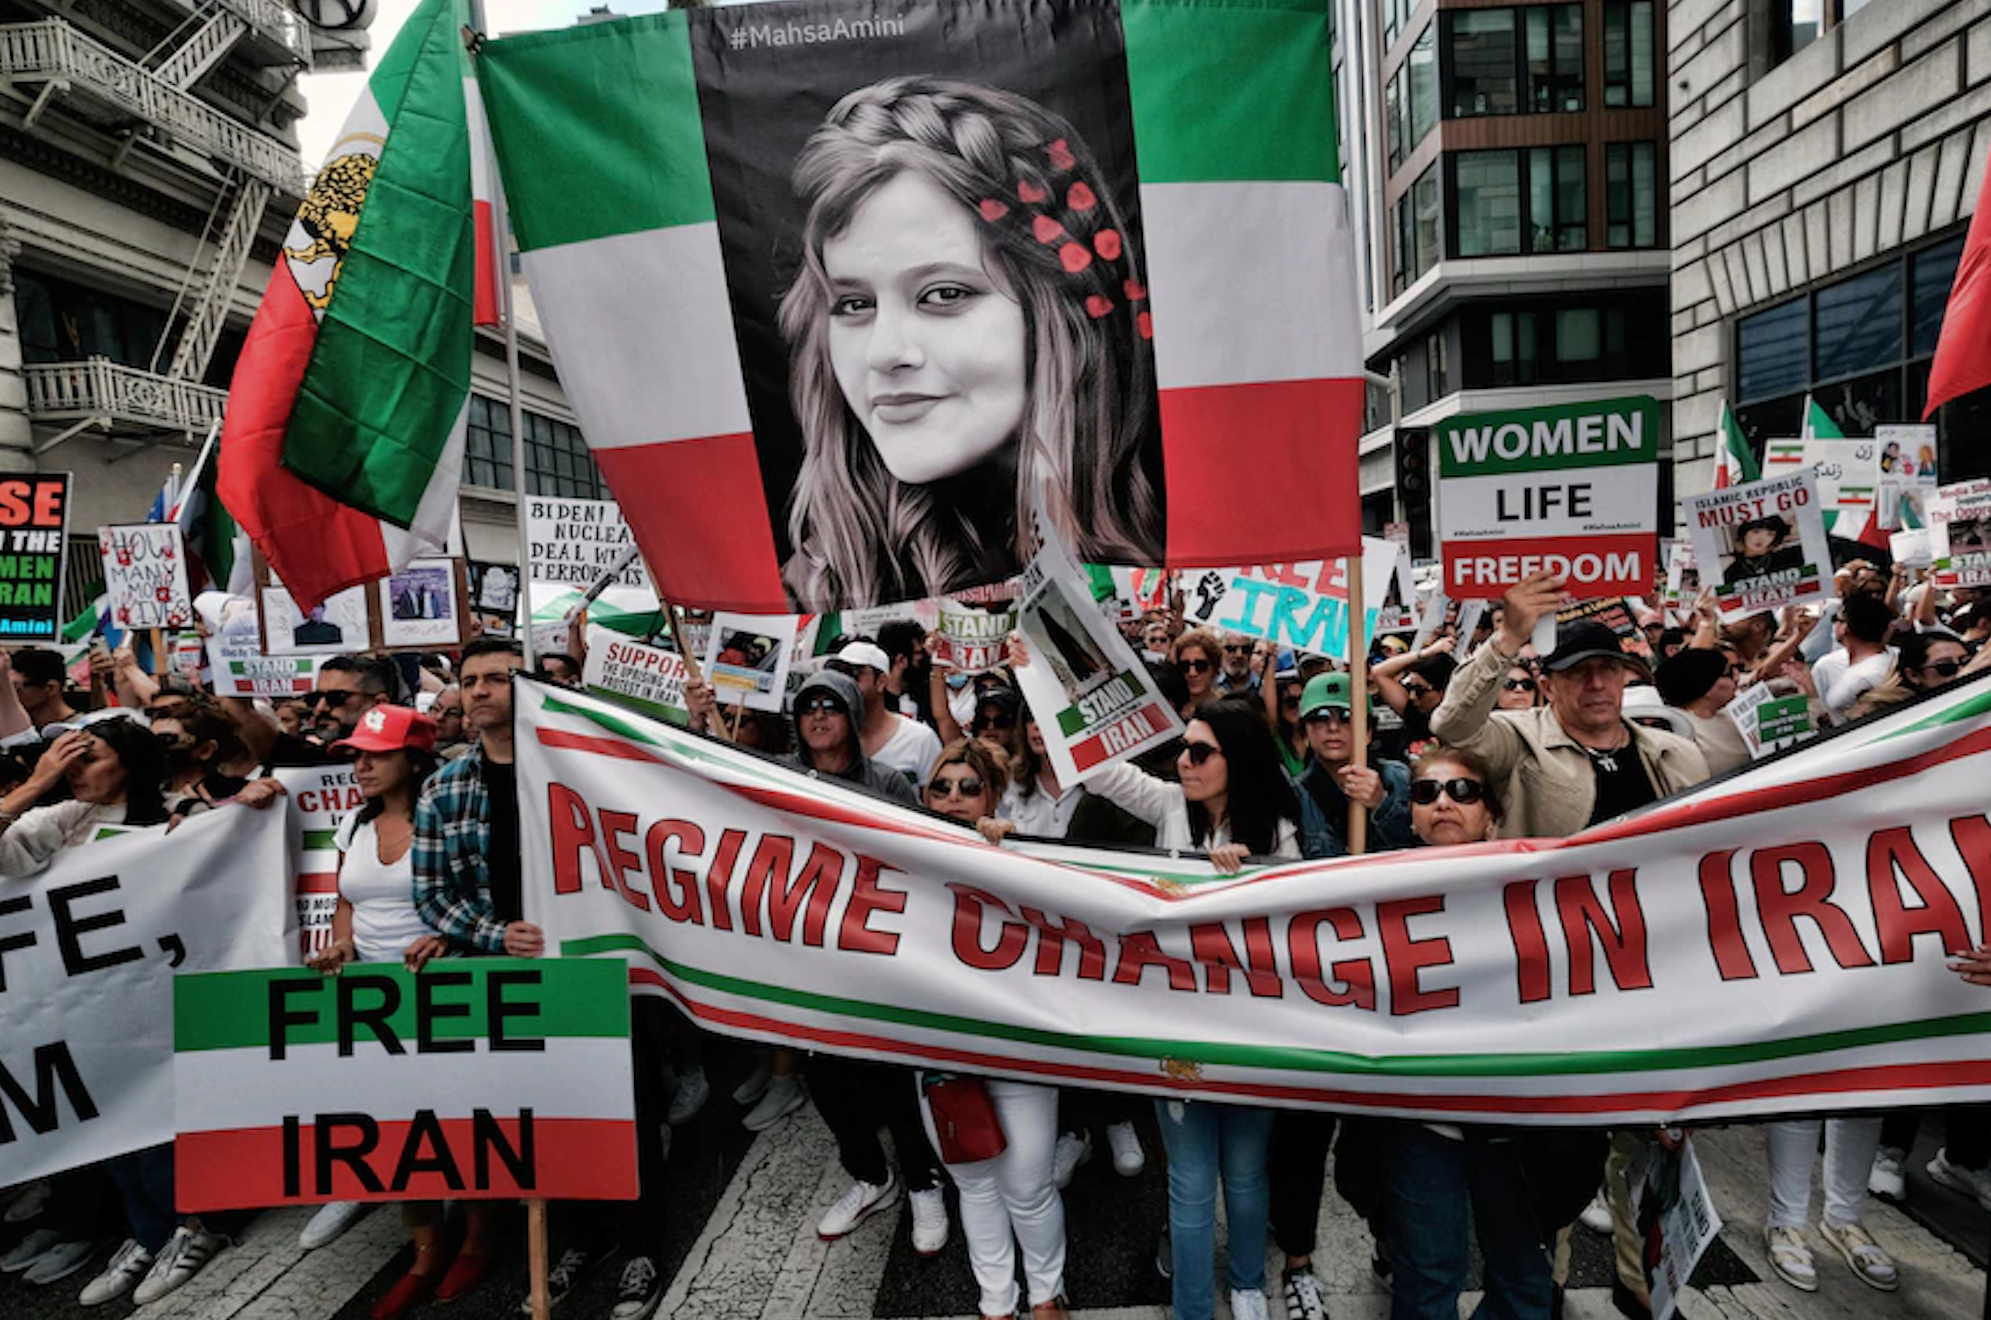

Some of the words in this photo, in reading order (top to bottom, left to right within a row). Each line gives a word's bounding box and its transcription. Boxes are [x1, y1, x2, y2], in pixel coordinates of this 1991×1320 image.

[730, 14, 905, 50] #MahsaAmini
[1449, 411, 1643, 464] WOMEN
[0, 479, 63, 526] SE
[1497, 483, 1592, 522] LIFE
[1695, 492, 1742, 509] ISLAMIC
[1745, 475, 1804, 499] REPUBLIC
[1698, 499, 1765, 529] MUST
[1777, 487, 1809, 512] GO
[531, 502, 605, 523] BIDEN!
[12, 530, 61, 553] THE
[531, 542, 585, 561] DEAL
[111, 563, 177, 583] MANY
[1453, 551, 1641, 586] FREEDOM
[1734, 570, 1801, 594] STAND
[942, 612, 1011, 638] STAND
[1220, 577, 1379, 659] IRAN
[1077, 676, 1134, 725] STAND
[1099, 711, 1155, 758] IRAN
[547, 782, 908, 956] REGIME
[945, 881, 1460, 1016] CHANGE
[1502, 866, 1655, 1004] IN
[269, 970, 545, 1060] FREE
[282, 1107, 537, 1197] IRAN
